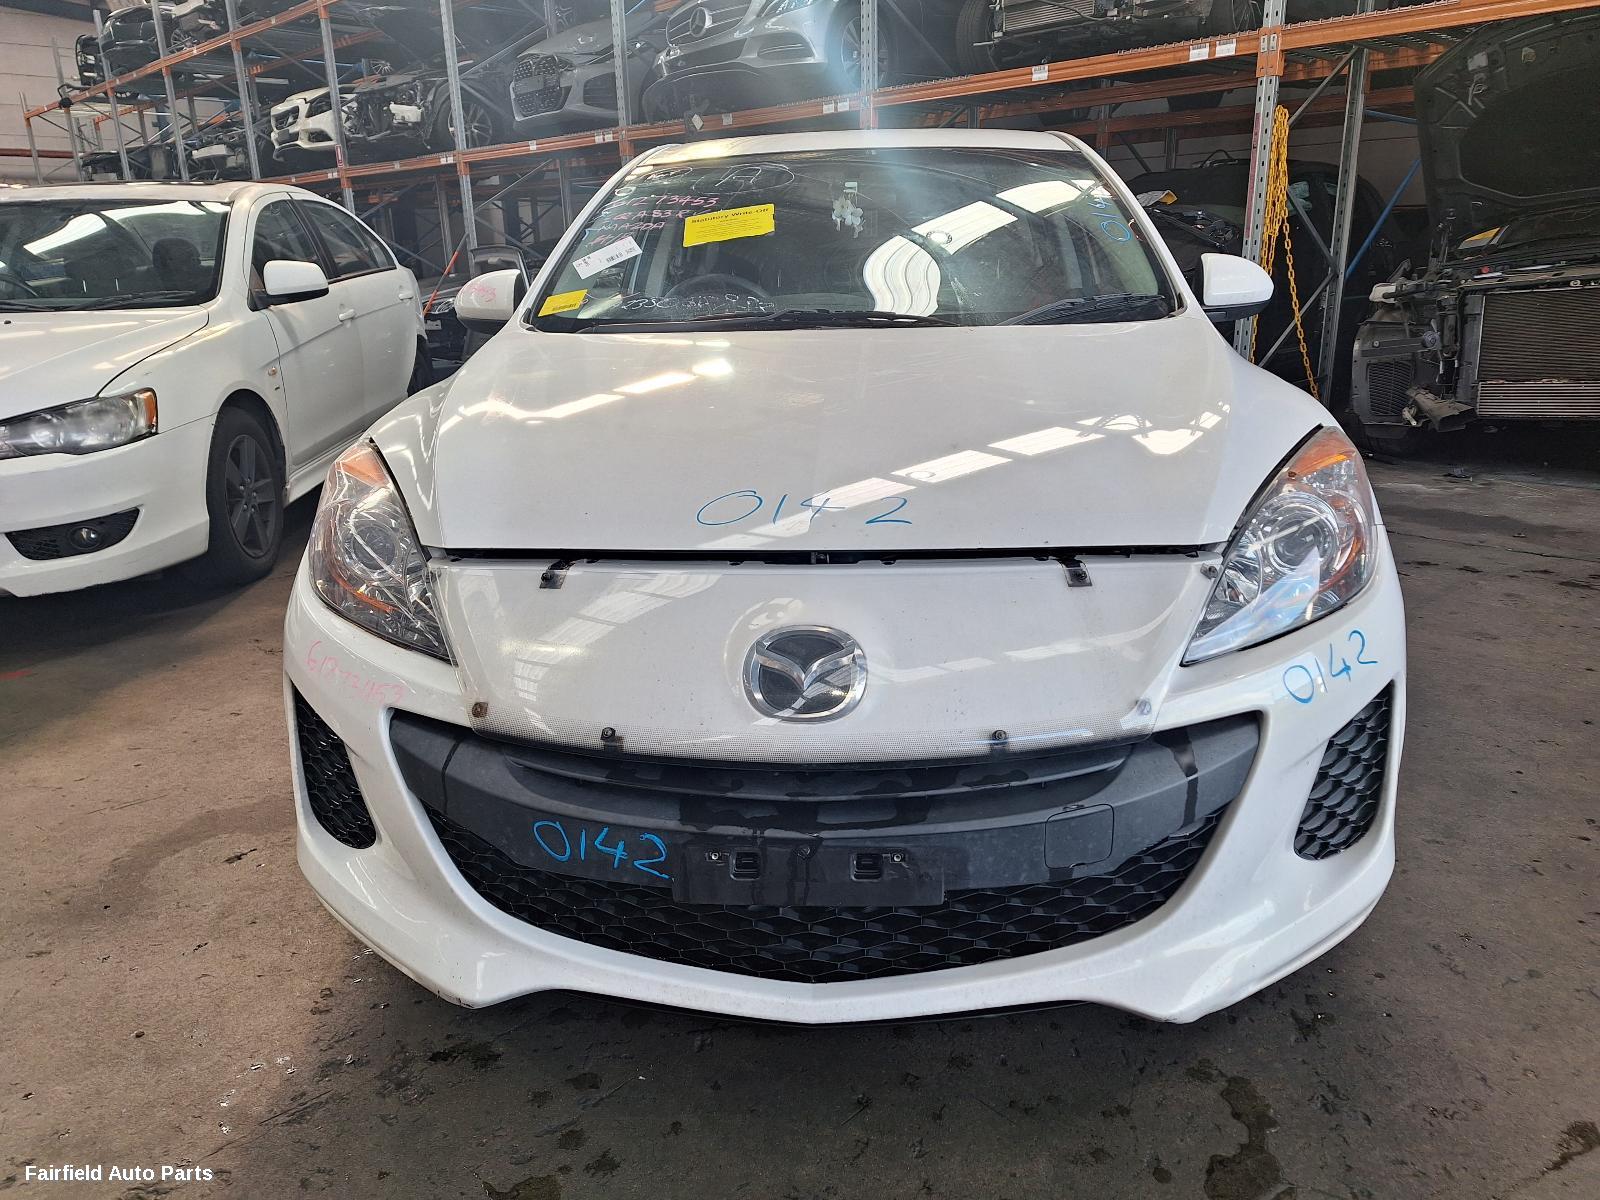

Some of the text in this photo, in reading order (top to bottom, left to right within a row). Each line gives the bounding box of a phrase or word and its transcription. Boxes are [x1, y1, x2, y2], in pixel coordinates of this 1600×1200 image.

[696, 489, 912, 526] 0142
[1282, 629, 1379, 704] 0142
[533, 820, 670, 879] 0142
